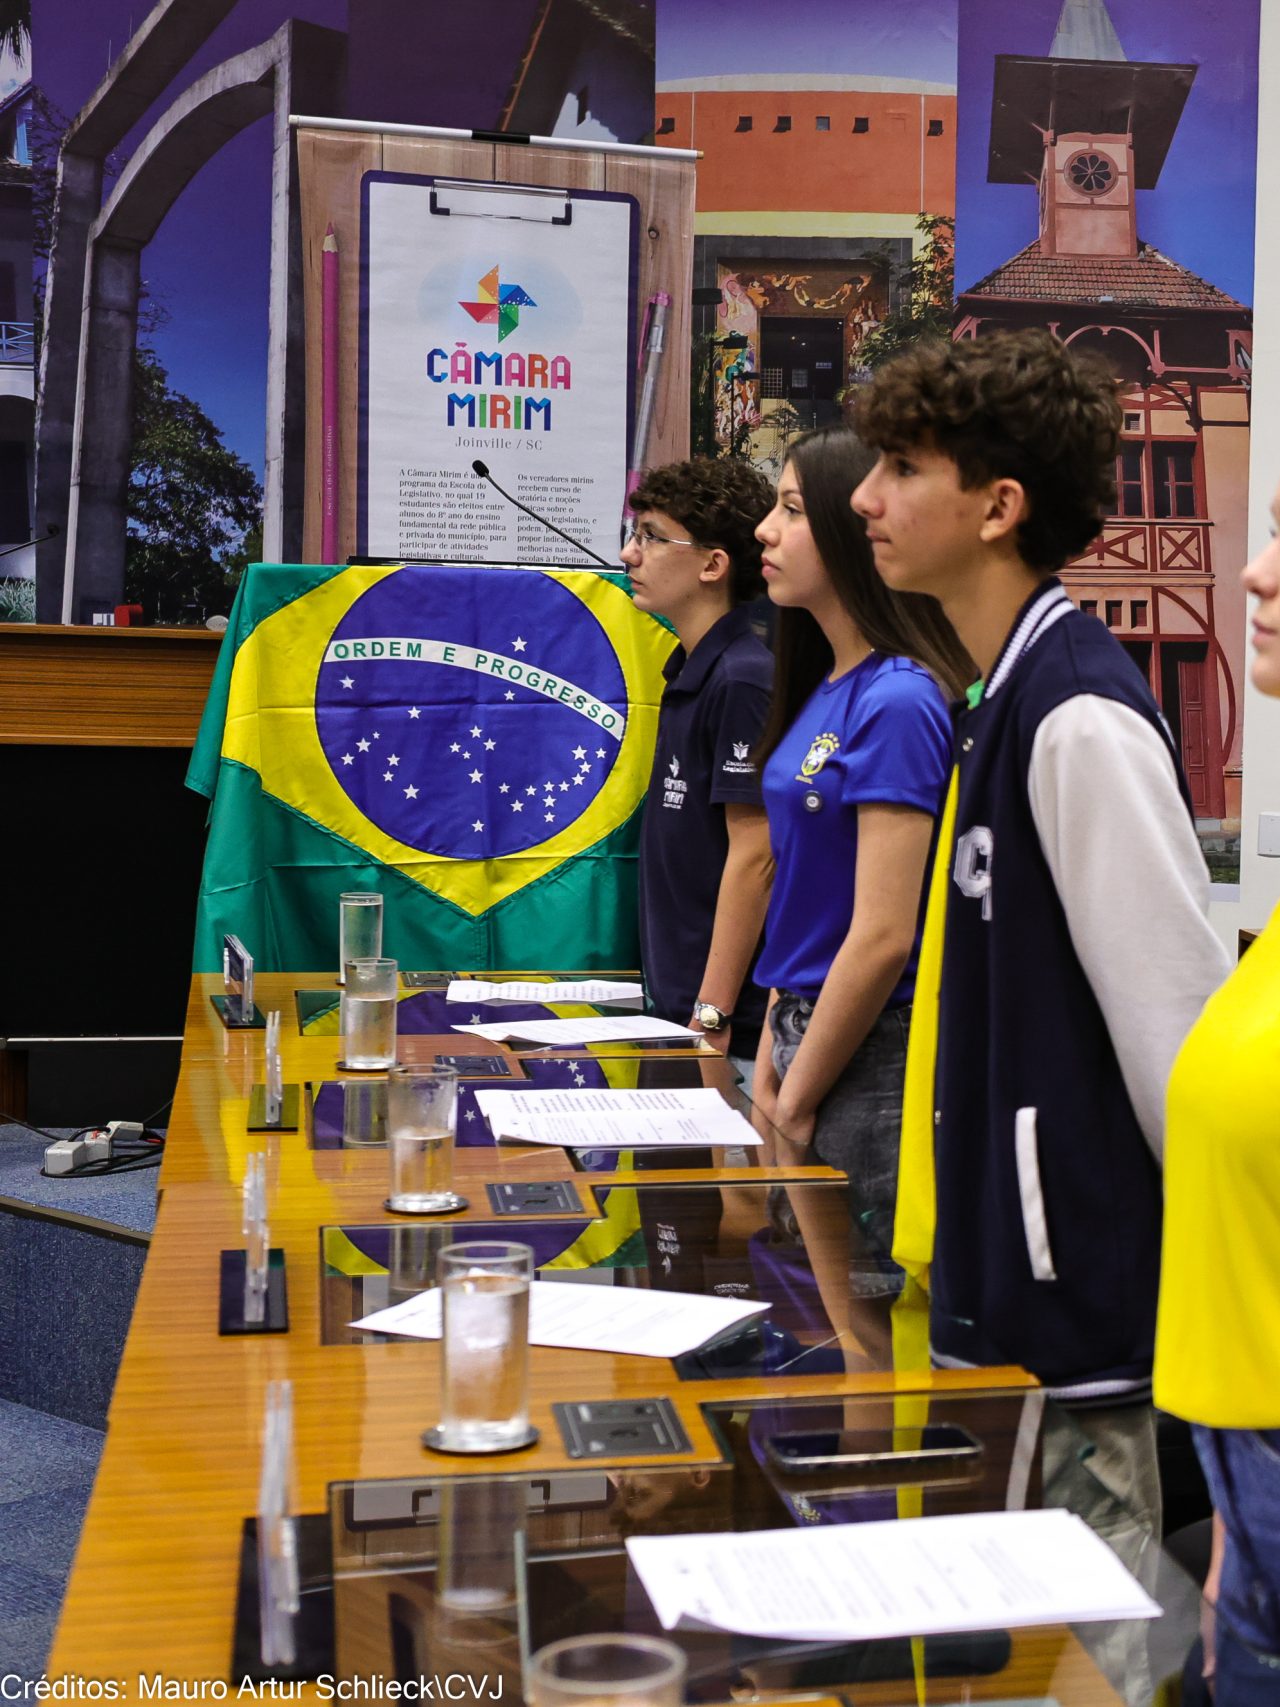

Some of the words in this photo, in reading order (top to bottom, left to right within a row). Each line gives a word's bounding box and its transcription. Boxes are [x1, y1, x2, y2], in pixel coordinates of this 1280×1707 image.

[447, 392, 552, 431] MIRIM
[455, 436, 512, 449] Joinville
[526, 439, 543, 451] SC
[400, 469, 405, 477] A
[407, 468, 437, 477] Câmara
[439, 470, 462, 479] Mirim
[529, 475, 569, 483] vereadores
[570, 476, 594, 484] mirins
[399, 480, 437, 488] programa
[438, 480, 448, 488] da
[450, 481, 475, 490] Escola
[477, 482, 487, 490] do
[517, 484, 549, 492] recebem
[456, 492, 473, 500] qual
[517, 494, 547, 502] oratória
[555, 495, 581, 504] noções
[458, 502, 484, 510] eleitos
[546, 504, 567, 513] sobre
[399, 510, 425, 518] alunos
[399, 520, 446, 529] fundamental
[479, 523, 506, 532] pública
[406, 531, 435, 539] privada
[517, 535, 541, 543] propor
[543, 535, 582, 545] indicaçes
[399, 541, 437, 550] participar
[450, 542, 488, 550] atividades
[517, 545, 553, 553] melhorias
[517, 555, 544, 563] escolas
[333, 641, 422, 659] ORDEM
[443, 646, 456, 663] E
[475, 653, 616, 730] PROGRESSO
